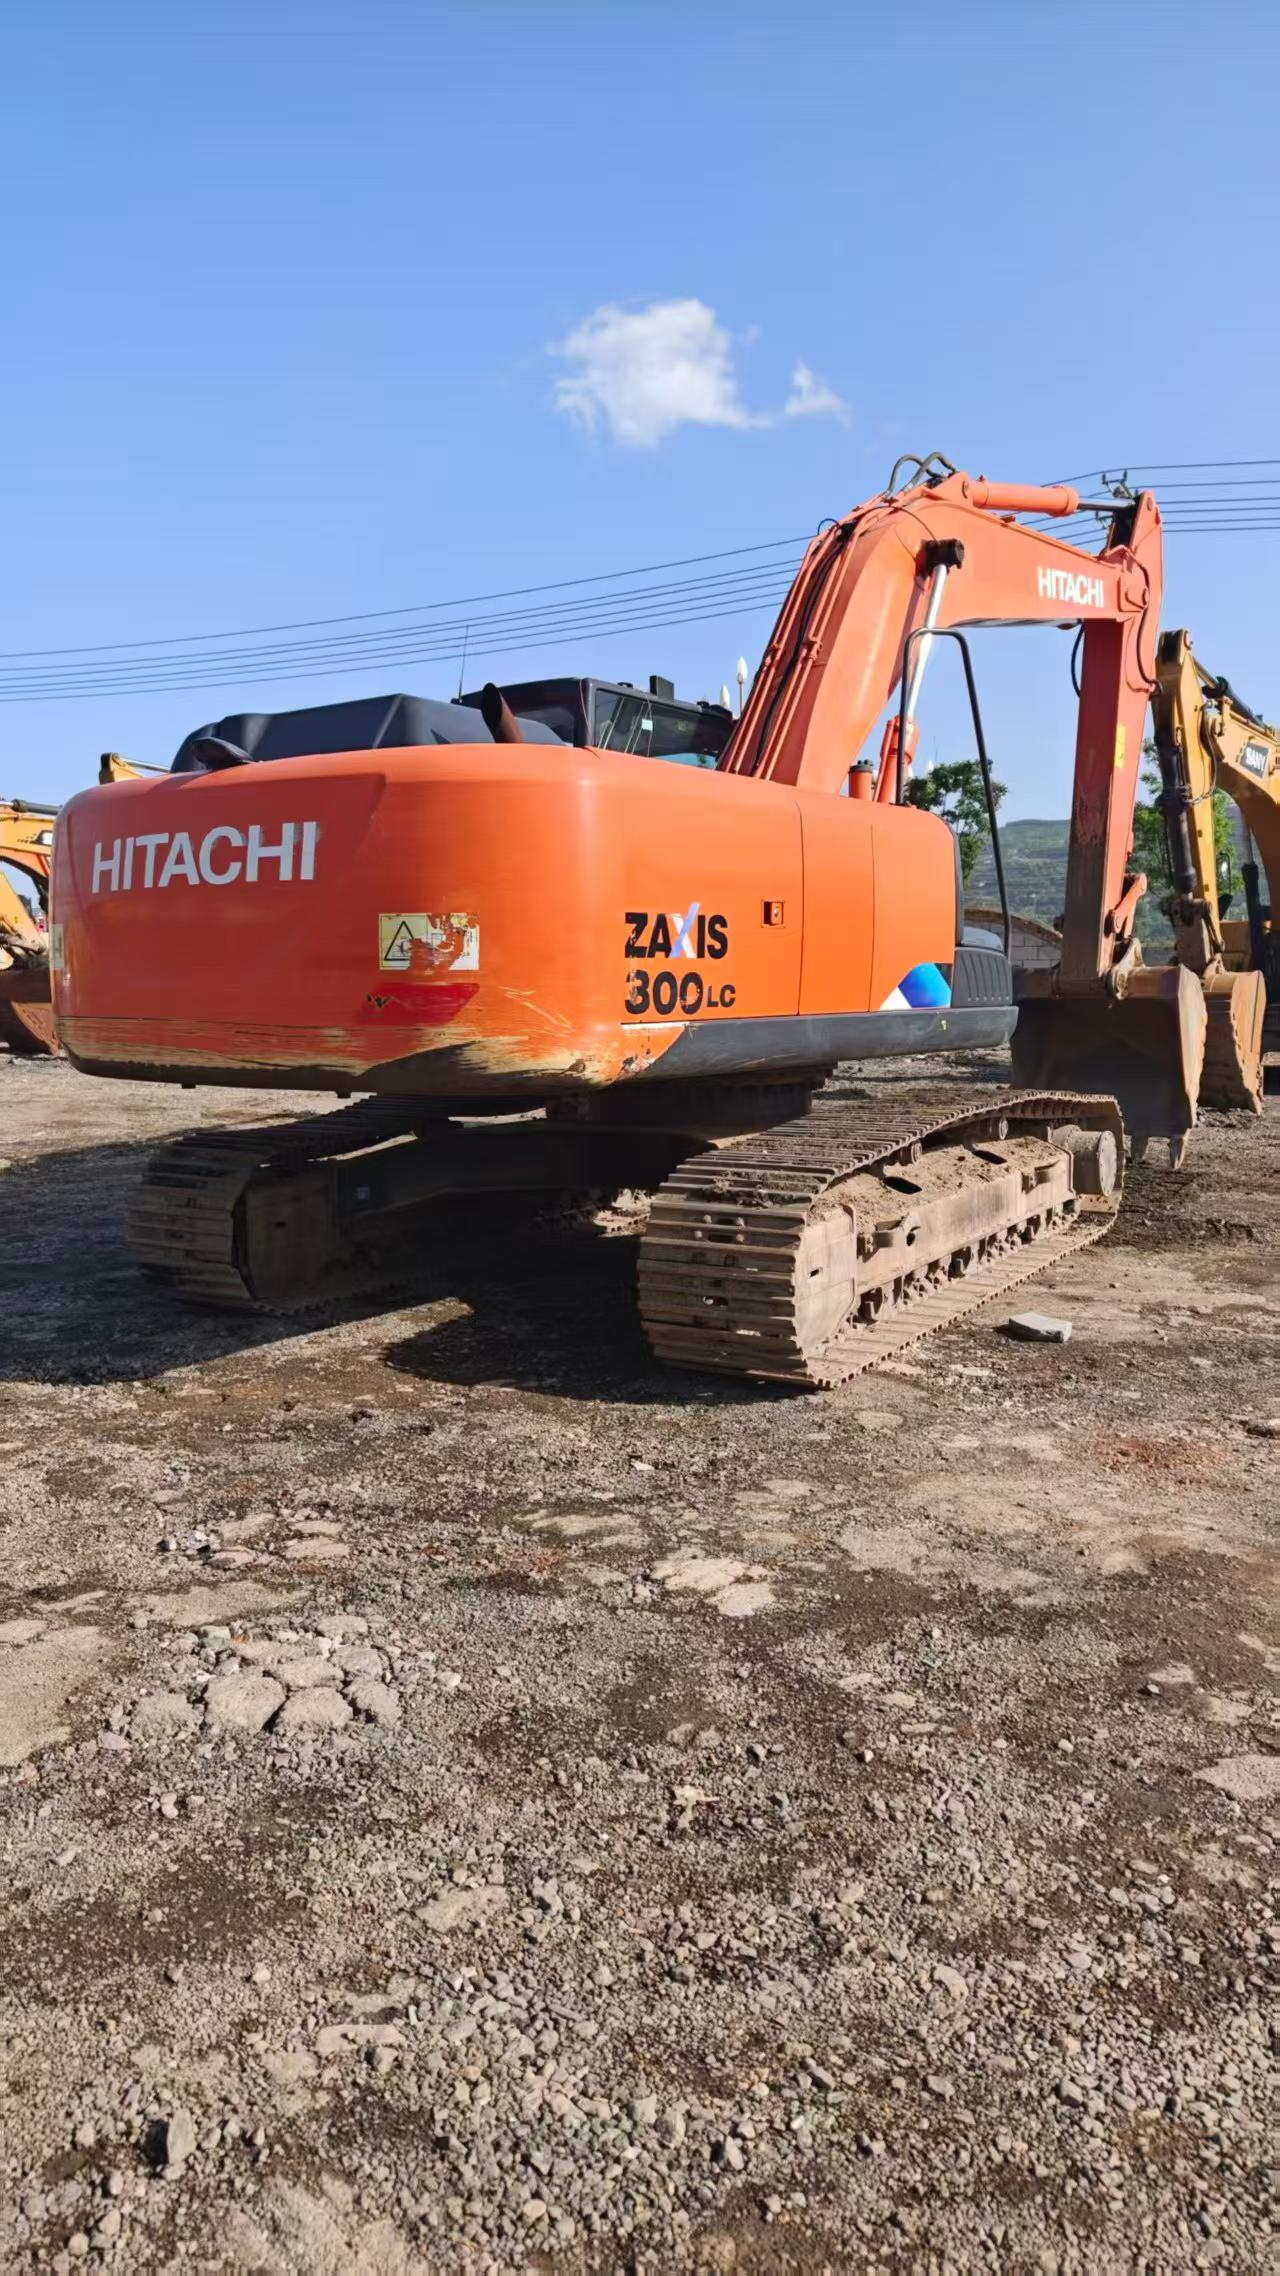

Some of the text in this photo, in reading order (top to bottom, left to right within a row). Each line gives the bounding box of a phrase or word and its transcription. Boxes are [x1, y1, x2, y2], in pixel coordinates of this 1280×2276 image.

[1037, 566, 1105, 608] HITACHI
[91, 820, 317, 894] HITACHI
[624, 902, 729, 960] ZAXIS
